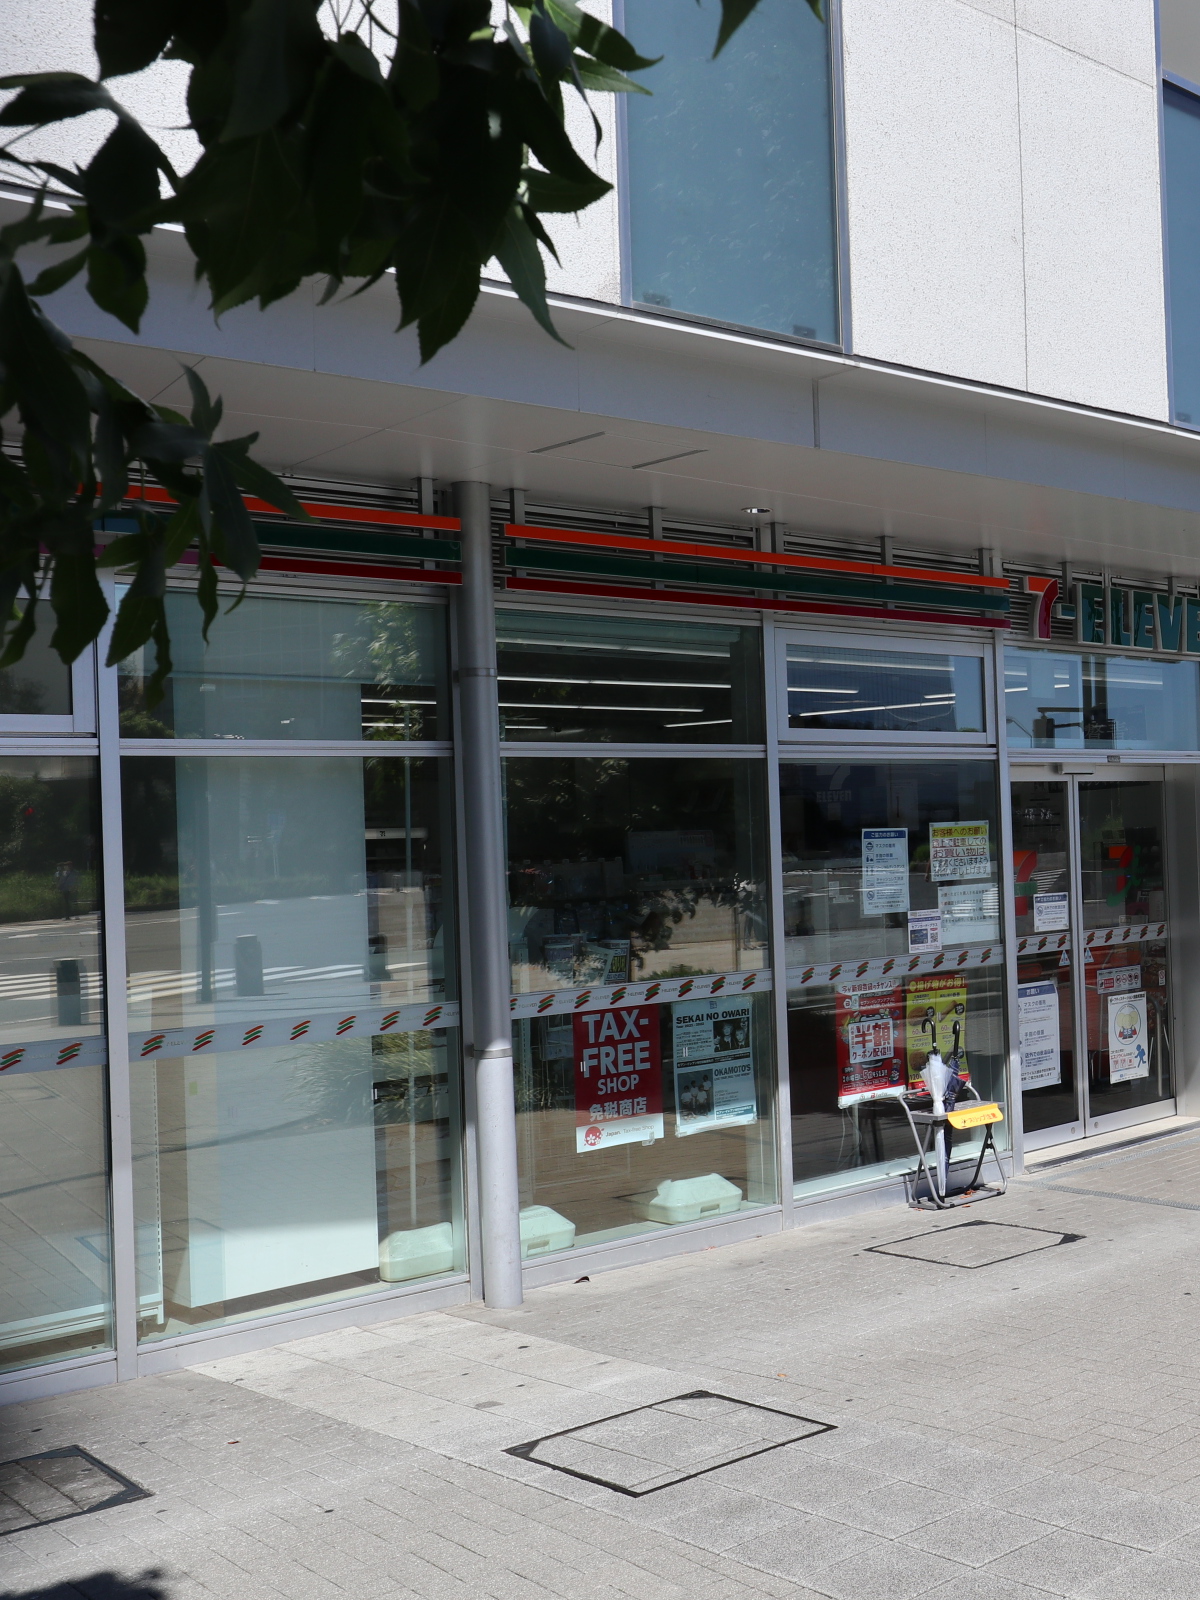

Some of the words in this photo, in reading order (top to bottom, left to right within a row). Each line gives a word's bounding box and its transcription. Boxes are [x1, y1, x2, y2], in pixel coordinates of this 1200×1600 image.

[582, 1009, 649, 1044] TAX-
[676, 1014, 704, 1025] SEKAI
[706, 1011, 719, 1020] NO
[722, 1008, 750, 1019] OWARI
[855, 1021, 891, 1049] 半額
[583, 1041, 651, 1079] FREE
[714, 1063, 752, 1077] OKAMOTO'S
[597, 1074, 640, 1096] SHOP
[589, 1096, 647, 1122] 免税商店
